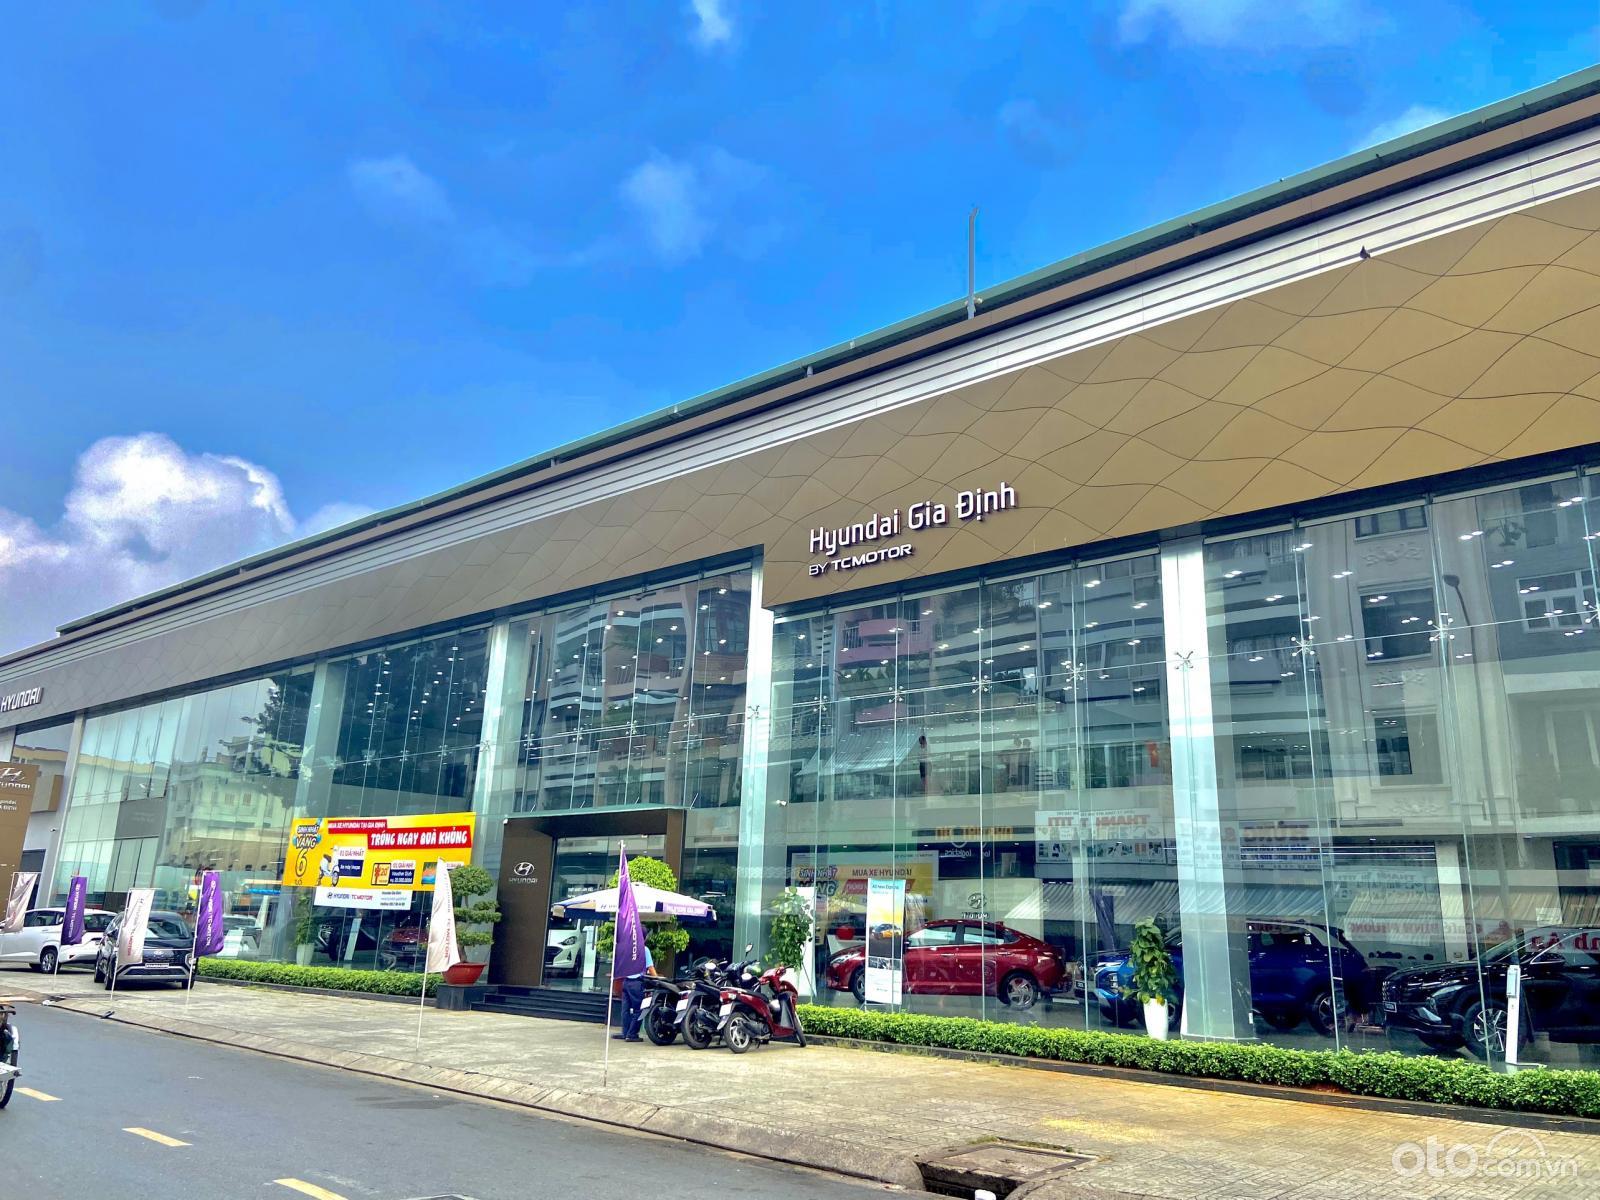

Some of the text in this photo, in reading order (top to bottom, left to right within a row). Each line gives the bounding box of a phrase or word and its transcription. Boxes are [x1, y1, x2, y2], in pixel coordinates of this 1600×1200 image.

[809, 481, 1017, 556] Hyundai Gia Định
[809, 543, 914, 576] BY TCMOTOR
[0, 687, 41, 712] HYUNDAI
[371, 830, 395, 845] TRÚNG
[397, 831, 418, 844] NGAY
[295, 850, 308, 877] 6
[869, 868, 878, 876] XE
[879, 868, 912, 876] HYUNDAI
